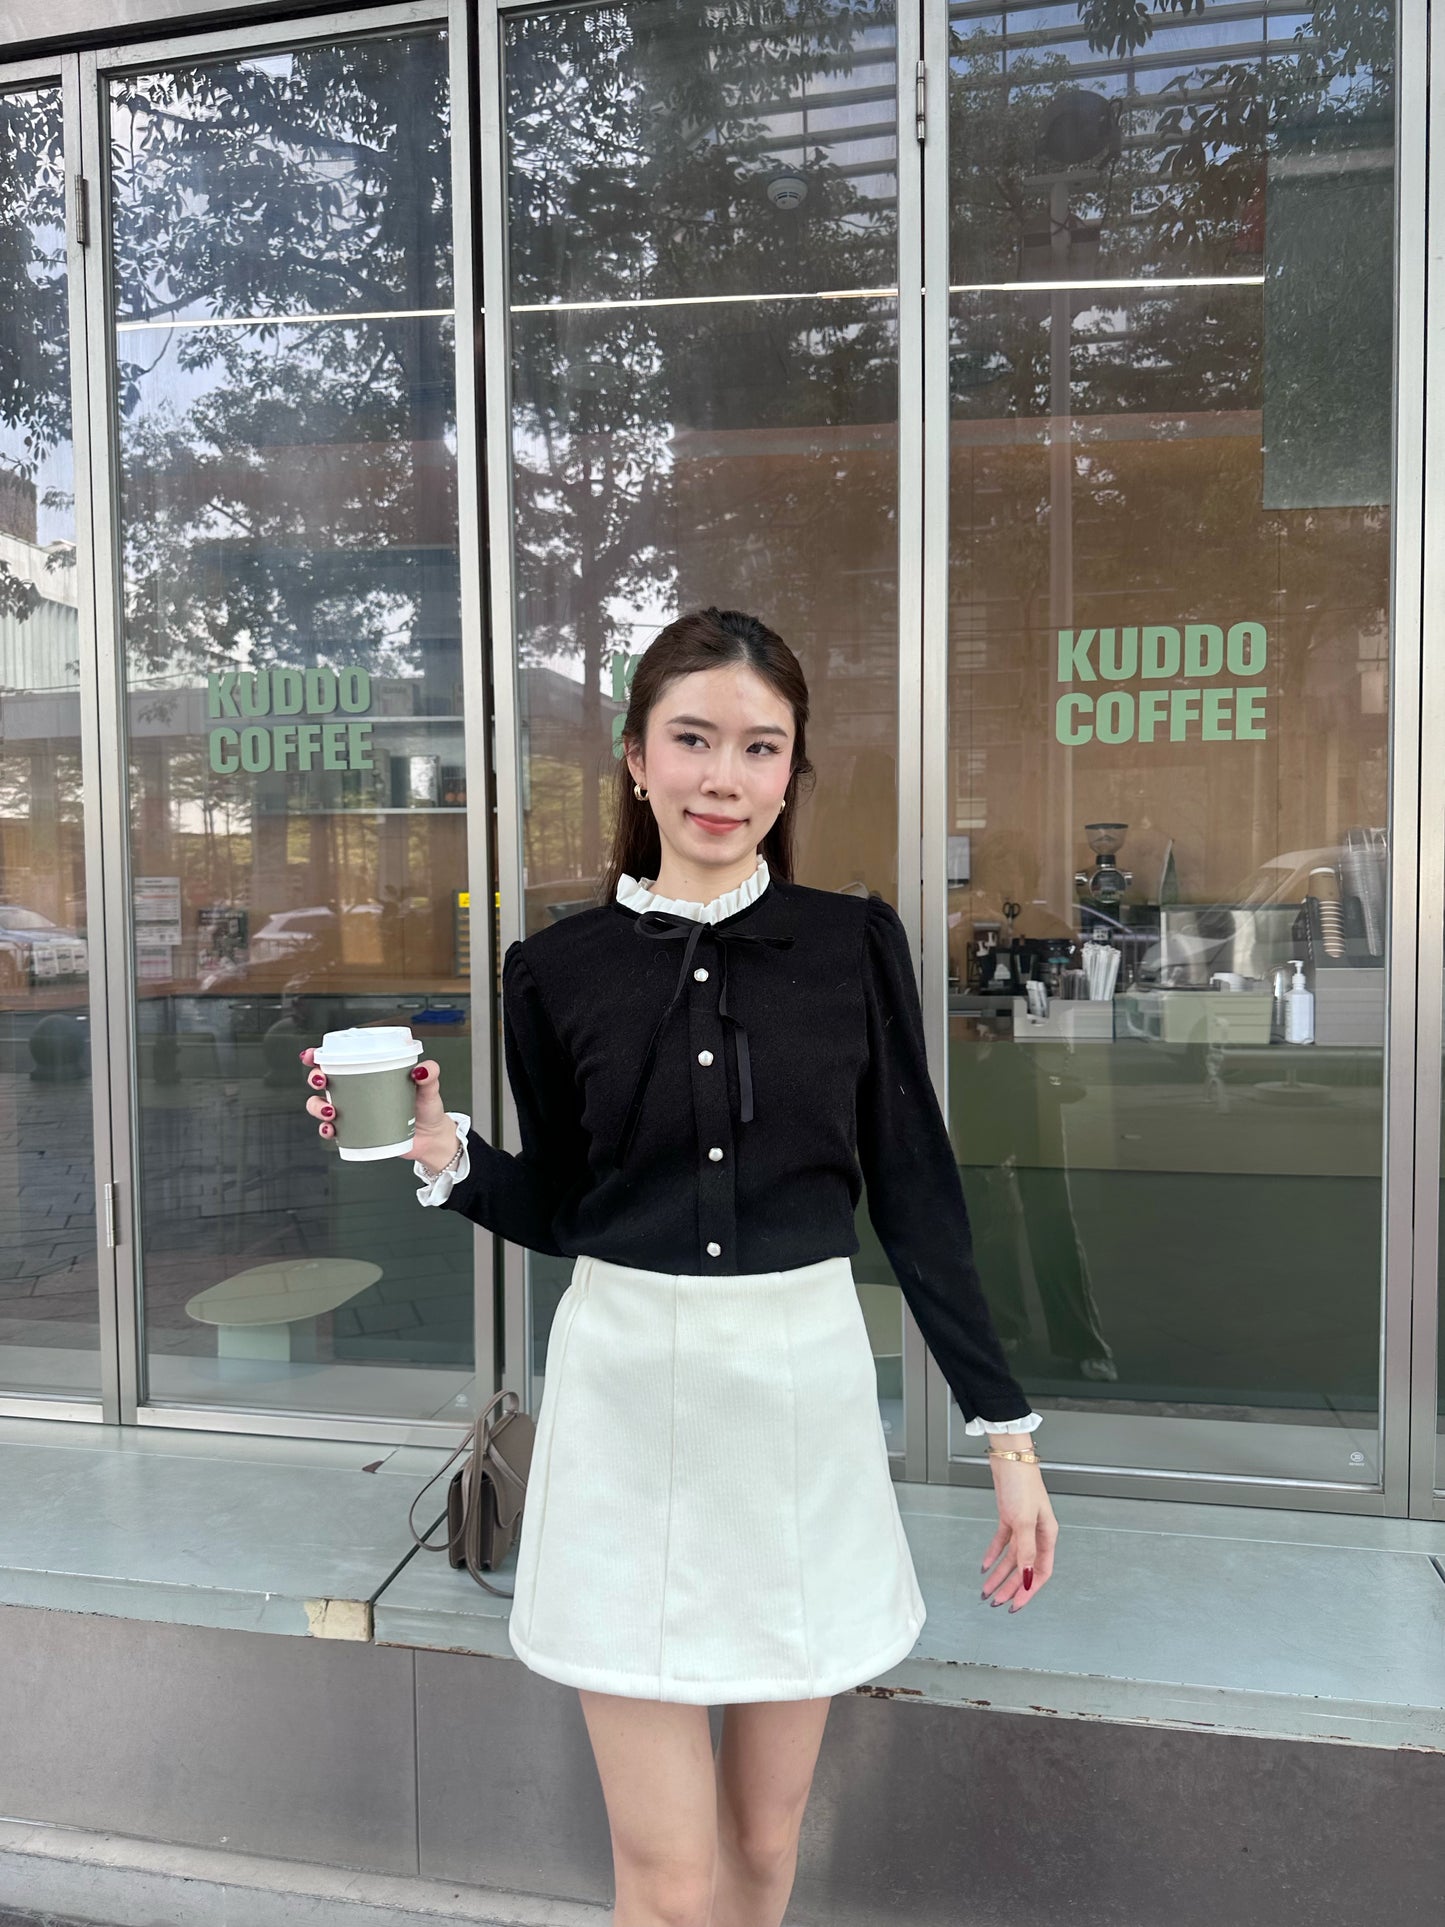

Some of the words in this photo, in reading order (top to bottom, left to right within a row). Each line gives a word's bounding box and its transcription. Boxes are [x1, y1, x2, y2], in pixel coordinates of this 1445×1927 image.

[1057, 621, 1267, 682] KUDDO
[208, 666, 371, 717] KUDDO
[1056, 687, 1267, 746] COFFEE
[209, 723, 374, 774] COFFEE
